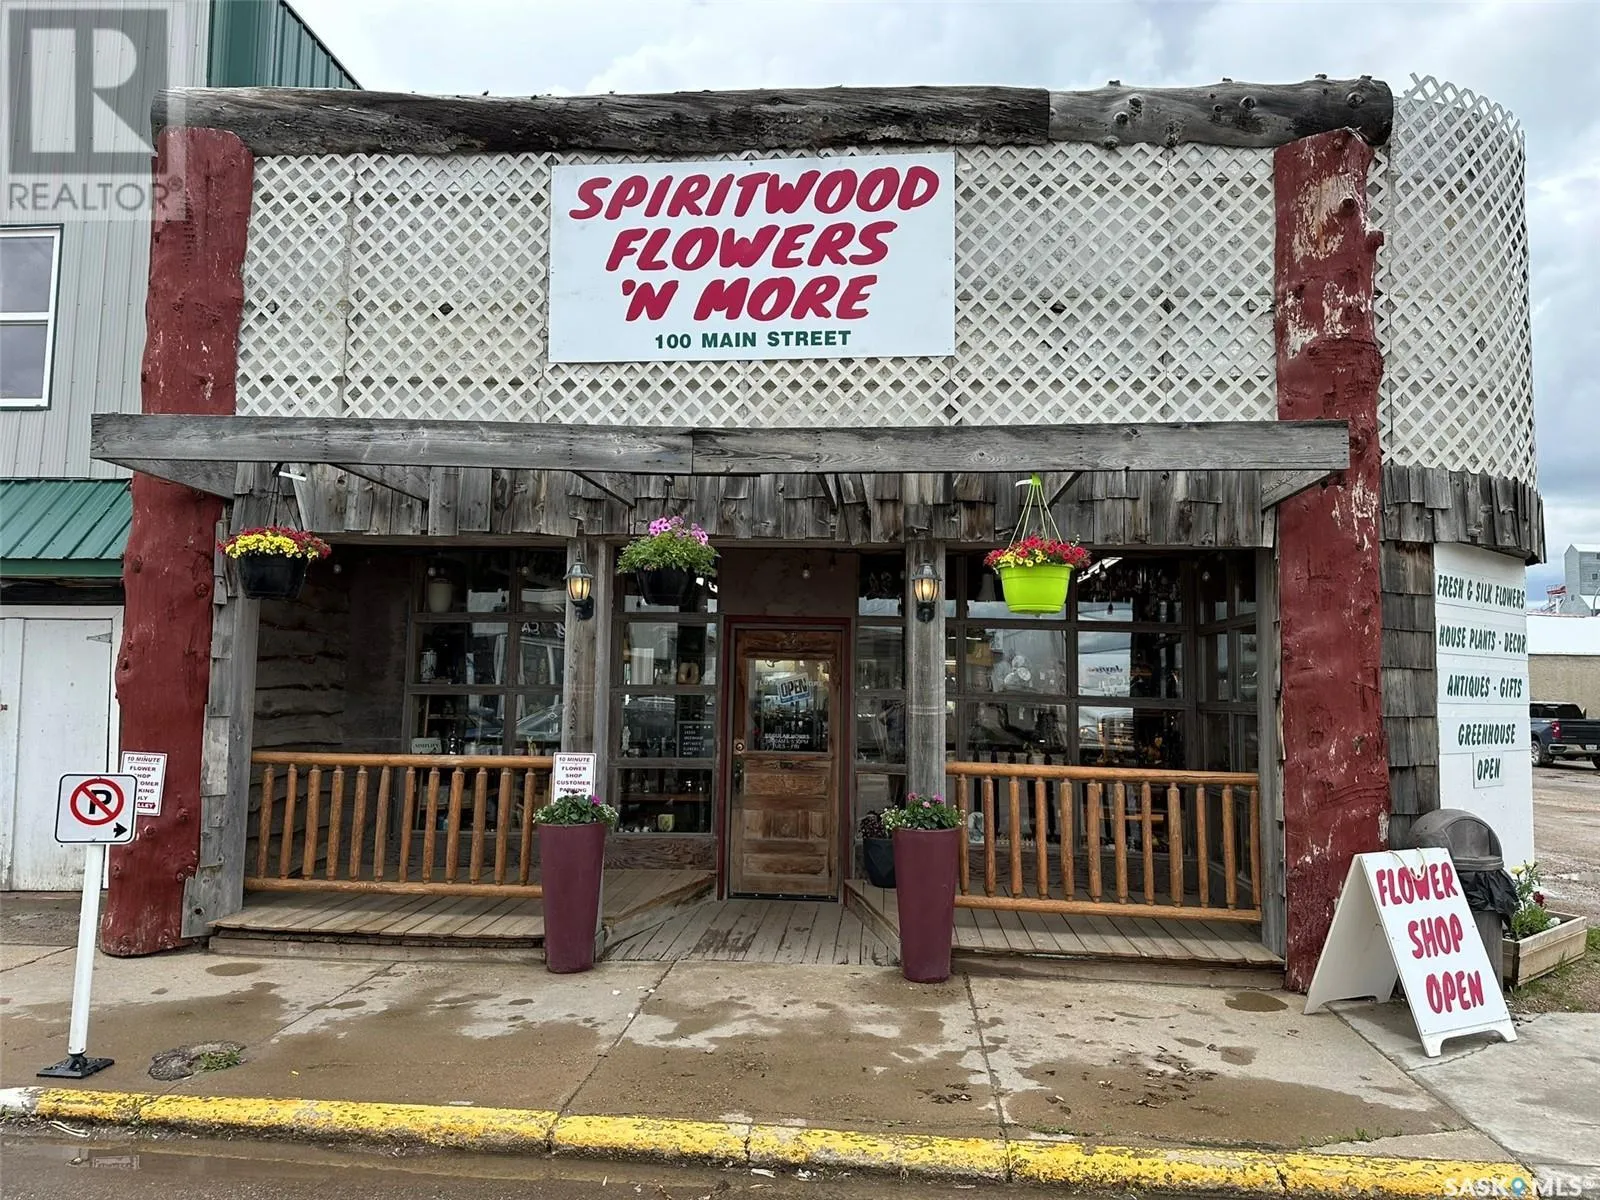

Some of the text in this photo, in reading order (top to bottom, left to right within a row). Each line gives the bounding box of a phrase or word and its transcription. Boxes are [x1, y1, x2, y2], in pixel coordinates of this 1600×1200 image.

[569, 166, 939, 220] SPIRITWOOD
[606, 221, 898, 272] FLOWERS
[694, 275, 878, 322] MORE
[655, 330, 852, 349] 100 MAIN STREET
[1437, 574, 1526, 610] FRESH & SILK FLOWERS
[1438, 624, 1467, 649] HOUSE
[1469, 628, 1497, 652] PLANTS
[1503, 632, 1527, 655] DECOR
[781, 678, 808, 698] OPEN
[1446, 674, 1491, 699] ANTIQUES
[1499, 677, 1523, 699] GIFTS
[1457, 723, 1516, 747] GREENHOUSE
[1476, 757, 1501, 781] OPEN
[1376, 861, 1459, 907] FLOWER
[1407, 913, 1464, 959] SHOP
[1425, 970, 1485, 1015] OPEN
